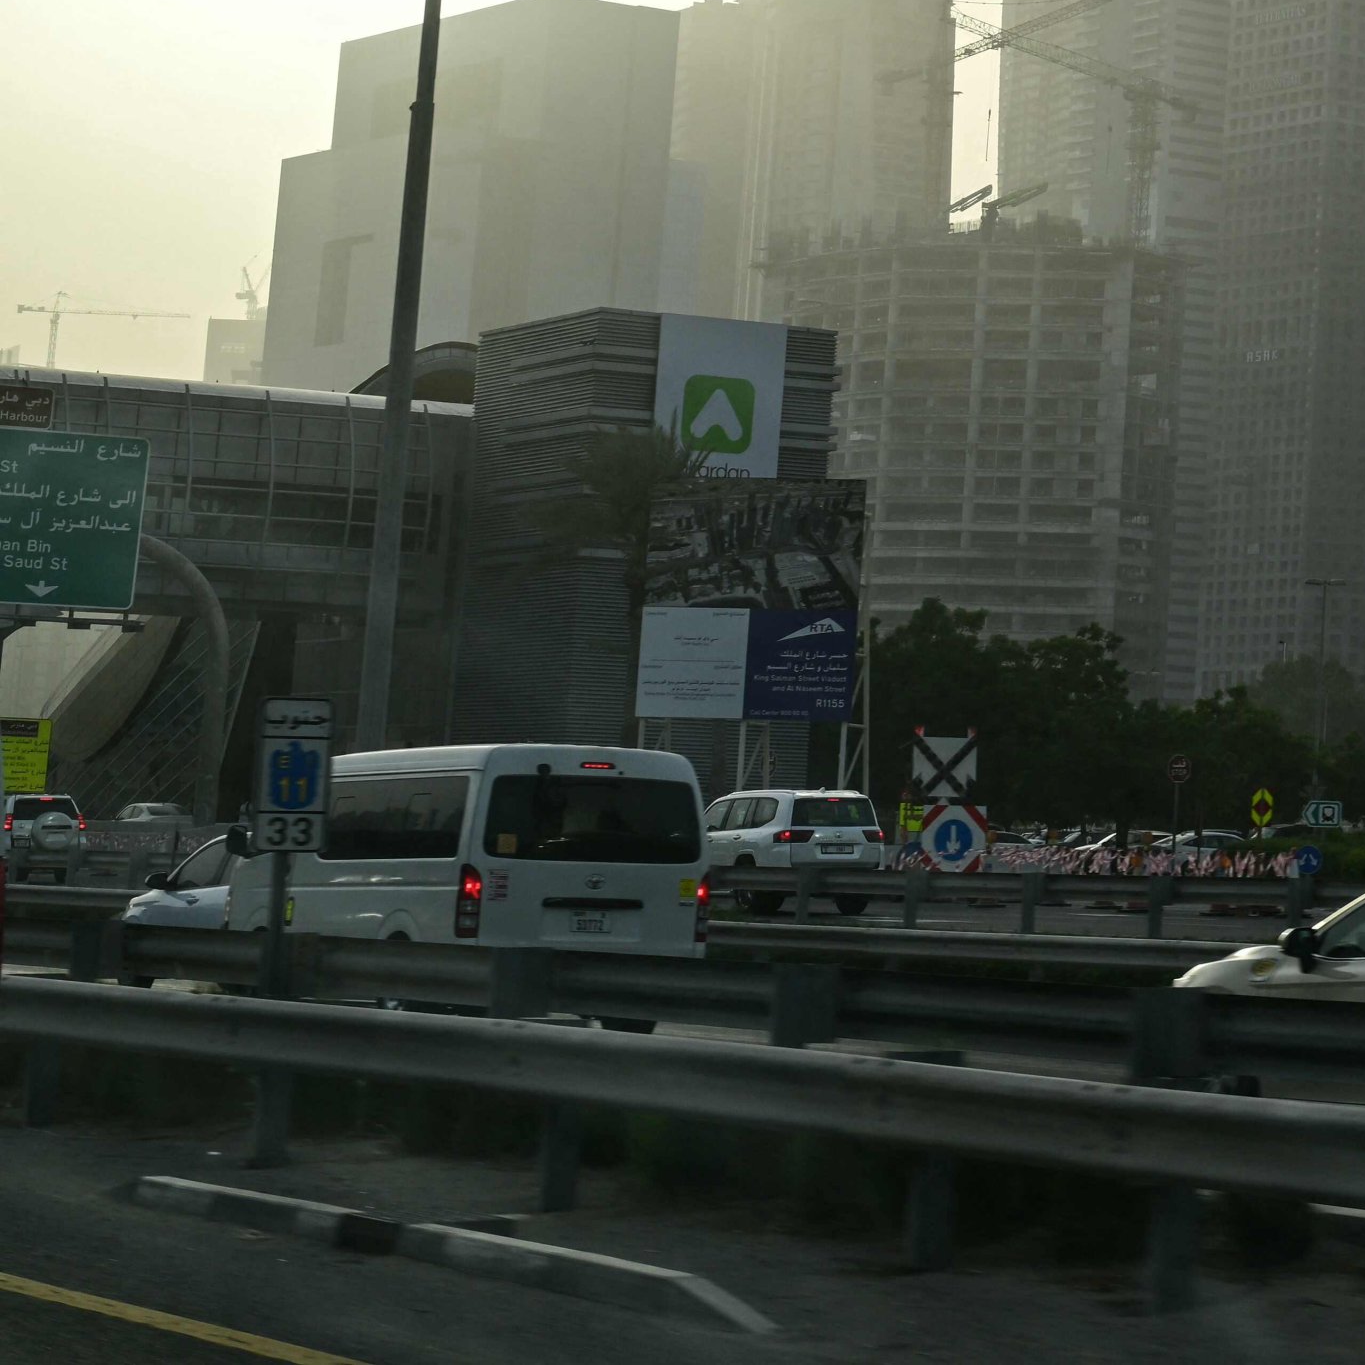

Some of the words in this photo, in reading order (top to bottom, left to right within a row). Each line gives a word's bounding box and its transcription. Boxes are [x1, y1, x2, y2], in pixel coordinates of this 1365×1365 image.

[25, 393, 50, 410] دبي
[0, 409, 48, 424] Harbour
[27, 438, 85, 456] النسيم
[96, 442, 142, 461] شارع
[0, 459, 19, 474] St
[0, 483, 50, 499] الملك
[56, 487, 101, 507] شارع
[109, 489, 136, 508] إلى
[20, 508, 41, 529] آل
[49, 514, 132, 534] عبدالعزيز
[27, 538, 51, 553] Bin
[3, 551, 43, 569] Saud
[50, 554, 68, 571] St
[810, 623, 835, 634] RTA
[804, 650, 827, 660] شارع
[793, 663, 815, 673] شارع
[816, 698, 845, 708] R1155
[263, 709, 331, 731] جنوب
[278, 755, 291, 770] E
[279, 776, 309, 803] 11
[265, 816, 314, 847] 33
